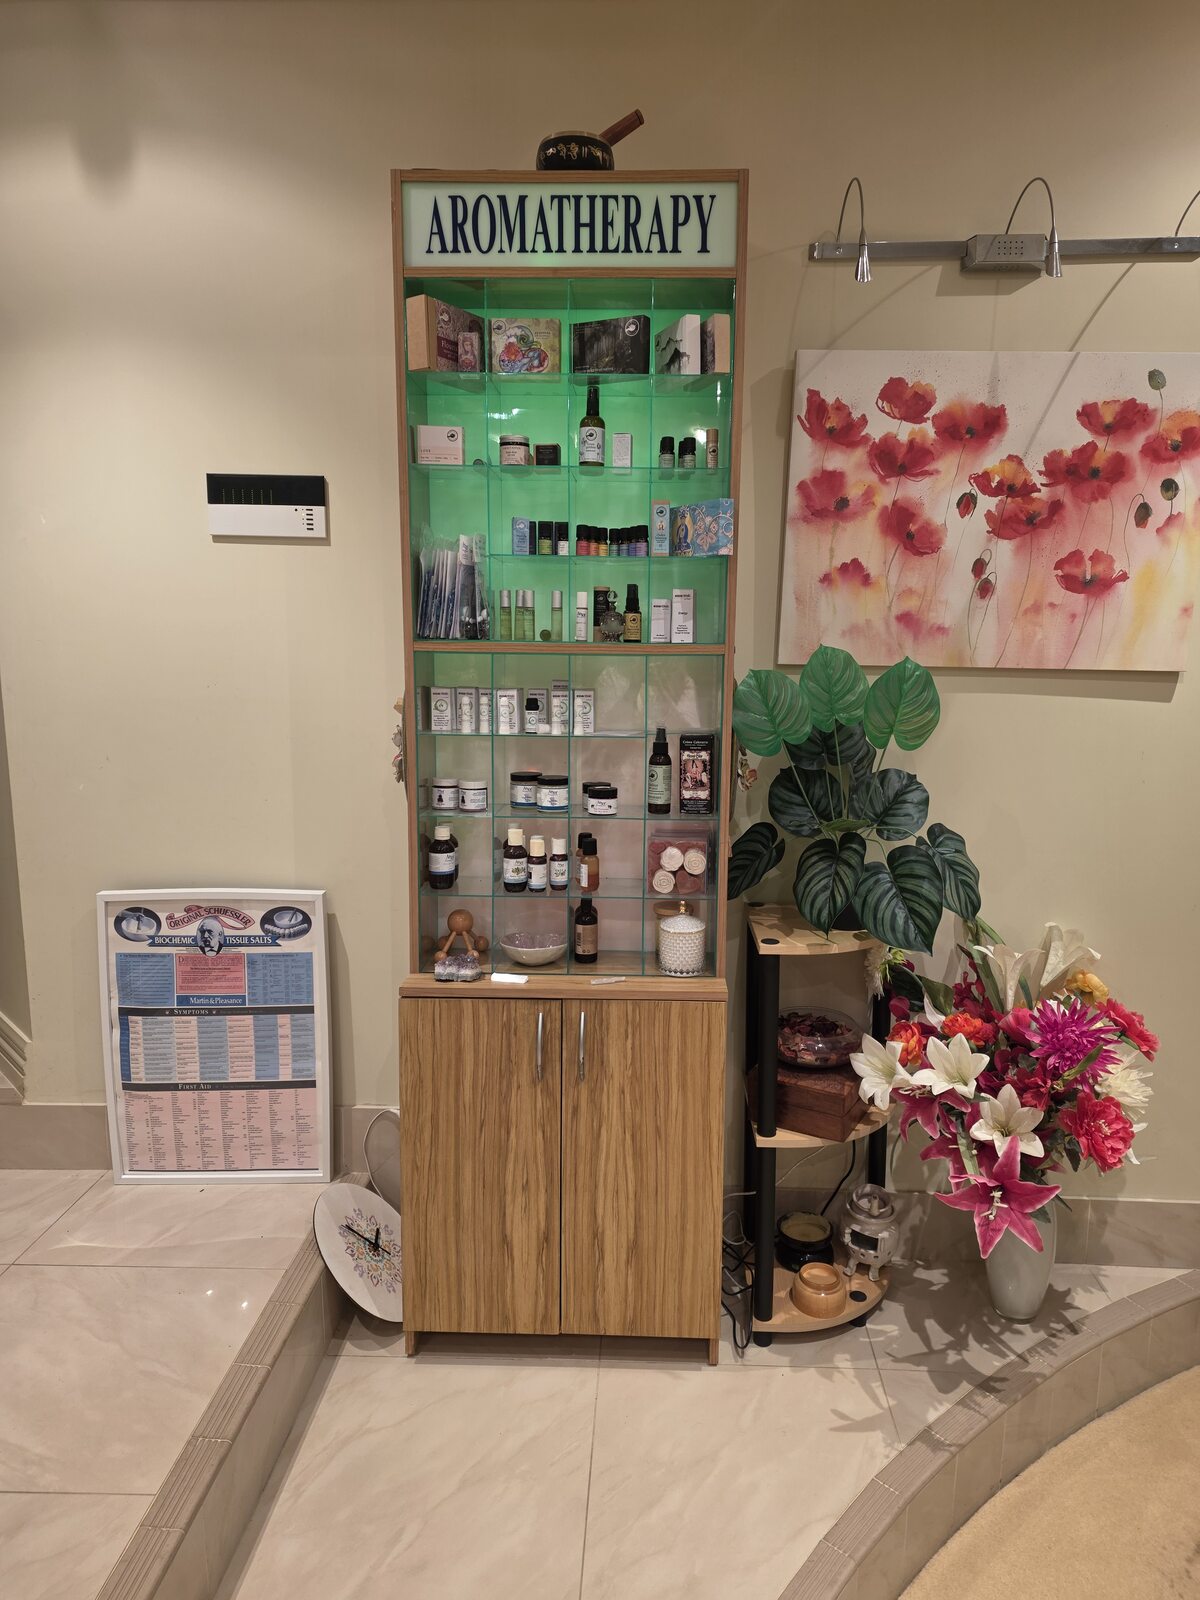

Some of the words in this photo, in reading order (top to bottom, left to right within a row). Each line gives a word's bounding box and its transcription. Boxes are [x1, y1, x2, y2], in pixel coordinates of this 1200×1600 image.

[425, 193, 717, 255] AROMATHERAPY
[169, 910, 204, 928] ORIGINAL
[204, 907, 251, 926] SCHUESSLER
[154, 936, 195, 944] BIOCHEMIC
[226, 936, 249, 944] TISSUE
[250, 936, 272, 944] SALTS
